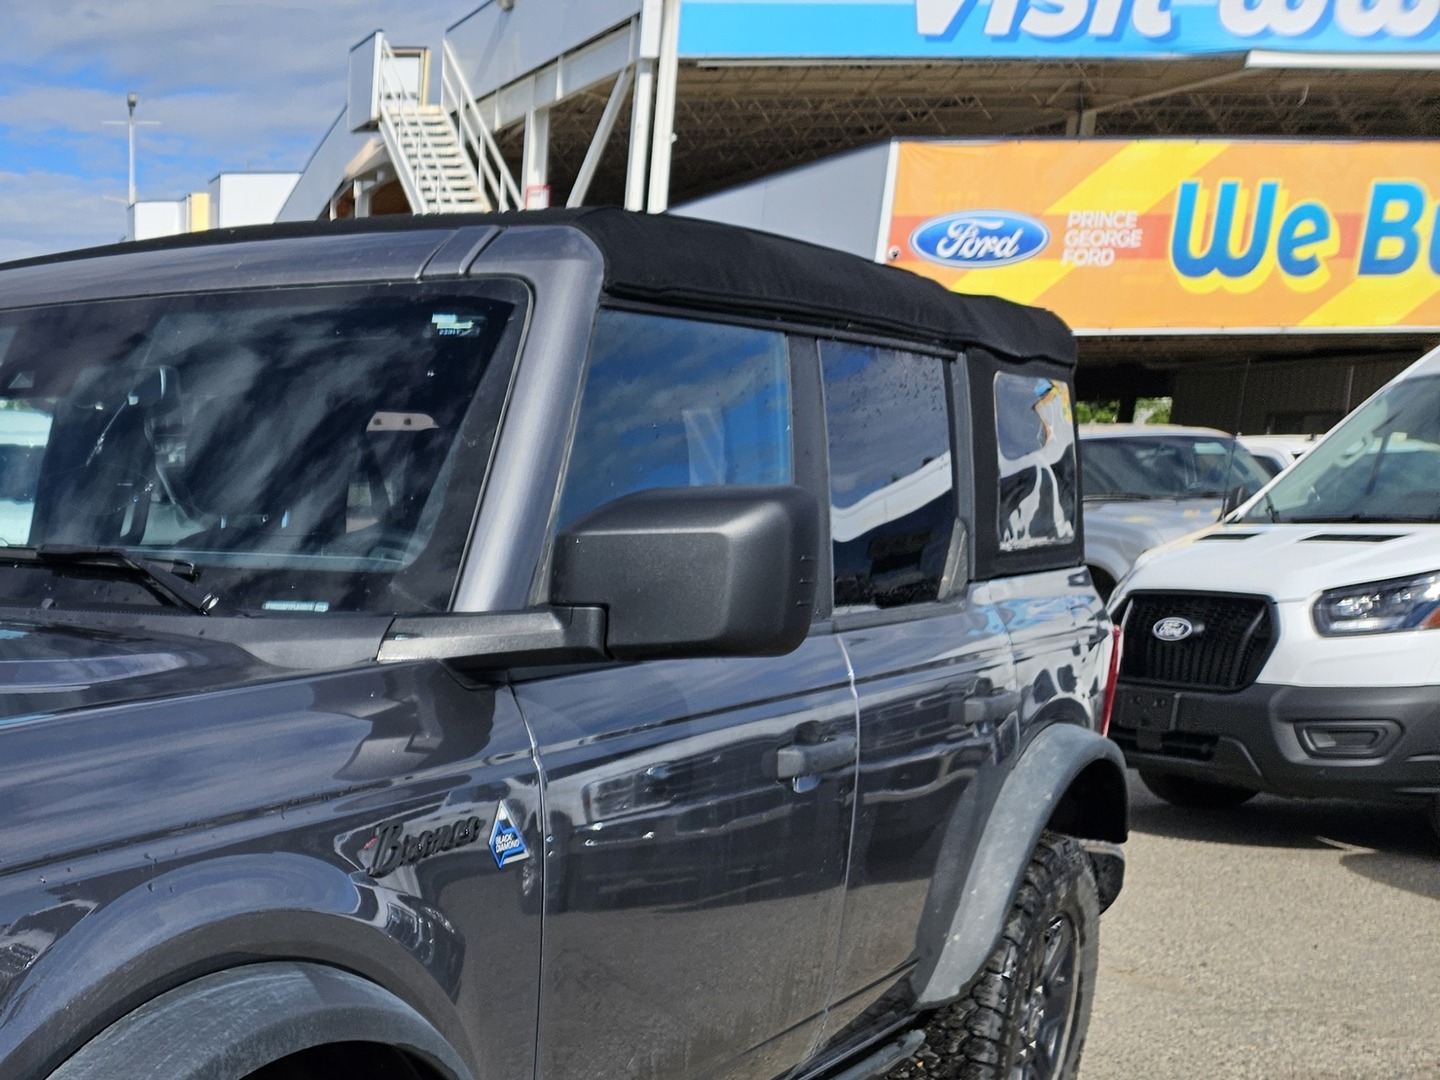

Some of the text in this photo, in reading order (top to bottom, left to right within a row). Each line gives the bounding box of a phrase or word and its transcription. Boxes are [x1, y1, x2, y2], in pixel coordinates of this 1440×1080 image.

[1066, 210, 1139, 229] PRINCE
[937, 218, 1024, 259] Ford
[1064, 229, 1143, 248] GEORGE
[1171, 181, 1331, 278] We
[1061, 248, 1115, 267] FORD
[367, 816, 486, 878] Bronco
[496, 833, 513, 845] BLACK
[496, 838, 520, 853] DIAMOND
